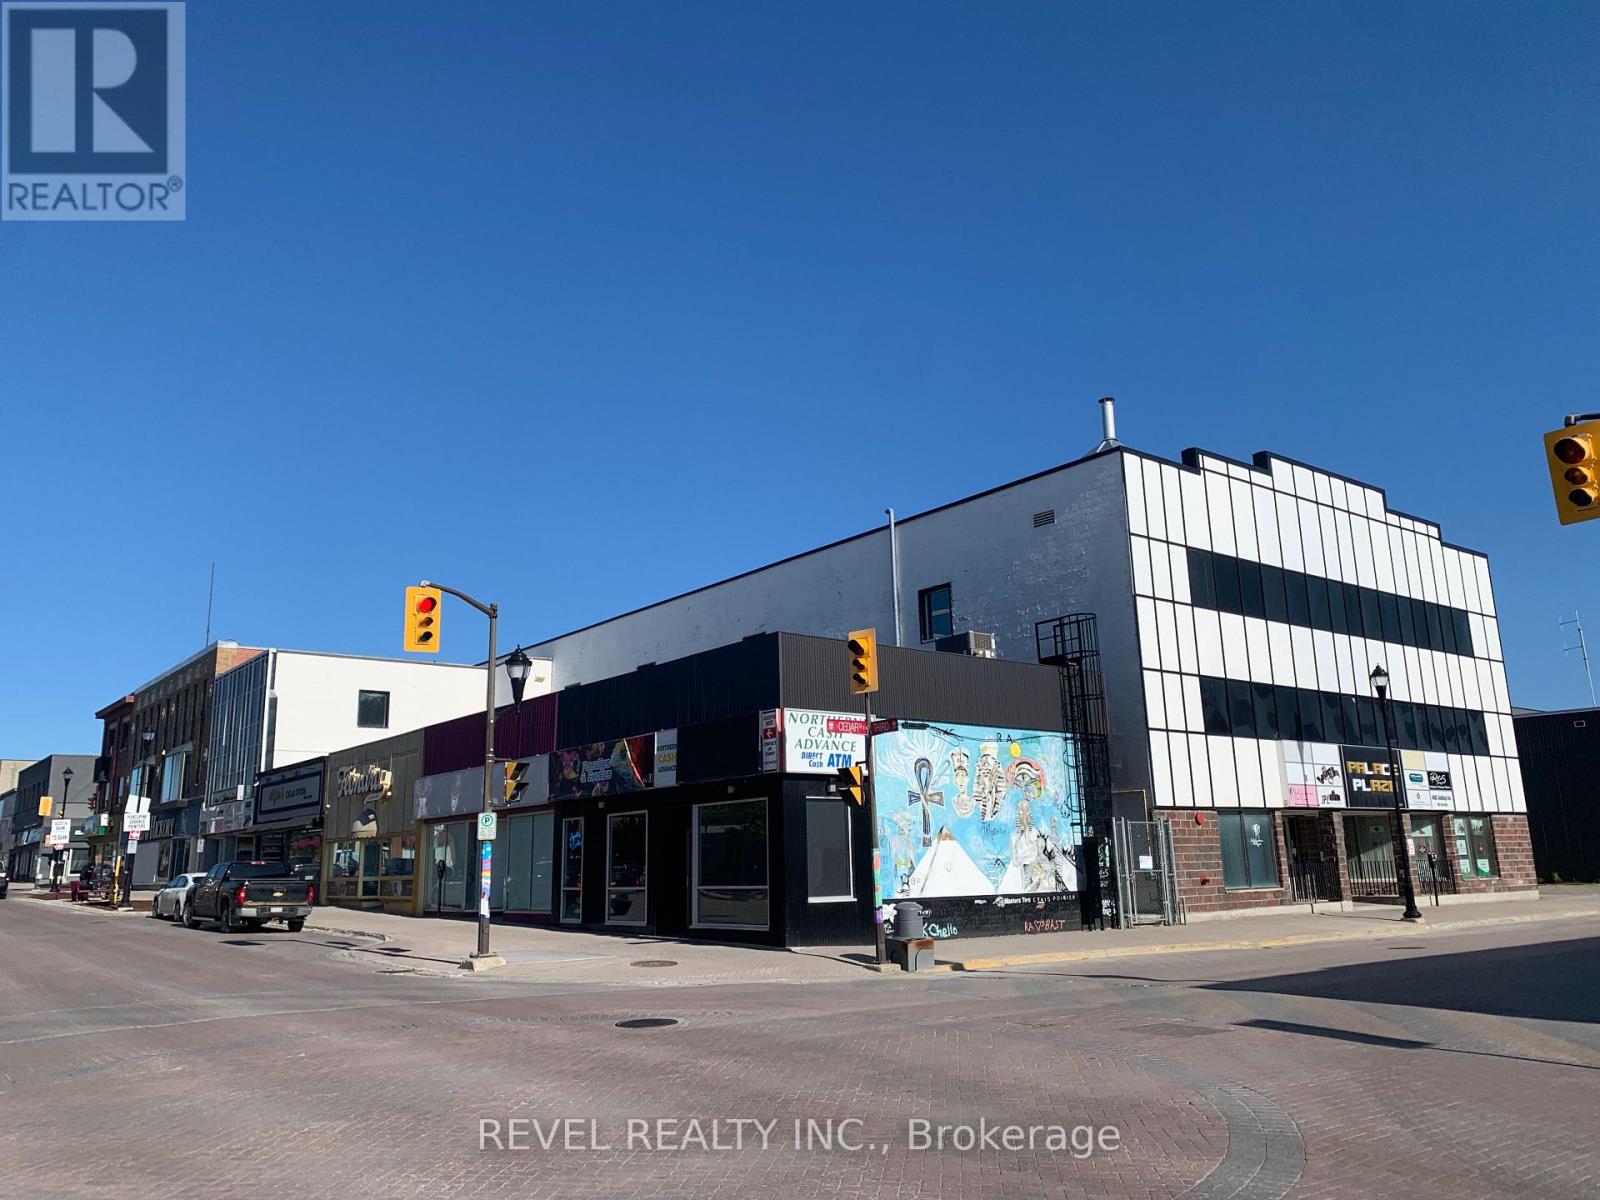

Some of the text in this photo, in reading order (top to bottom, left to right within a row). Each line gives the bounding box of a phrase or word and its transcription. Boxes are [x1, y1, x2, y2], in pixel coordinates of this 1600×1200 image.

[839, 721, 859, 732] CEDAR
[794, 739, 857, 752] ADVANCE
[801, 752, 852, 767] DIRECT ATM
[1346, 761, 1400, 776] PALACE
